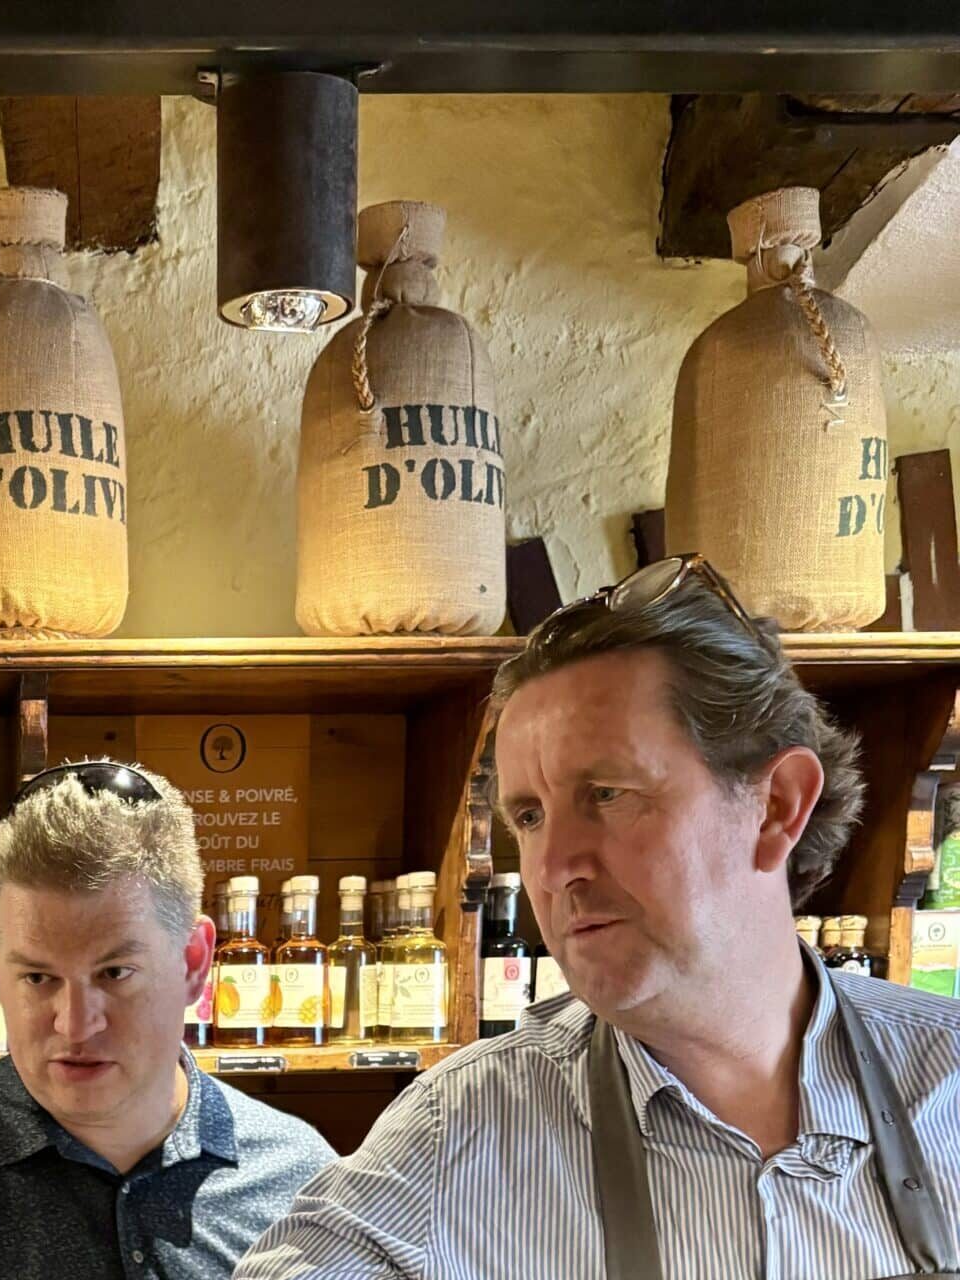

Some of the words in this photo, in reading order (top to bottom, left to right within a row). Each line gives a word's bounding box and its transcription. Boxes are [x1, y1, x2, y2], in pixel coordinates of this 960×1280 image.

[381, 403, 504, 457] HUIL
[218, 789, 230, 803] &
[236, 787, 298, 804] POIVRÉ,
[262, 812, 281, 825] LE
[236, 835, 260, 849] DU
[251, 858, 295, 872] FRAIS
